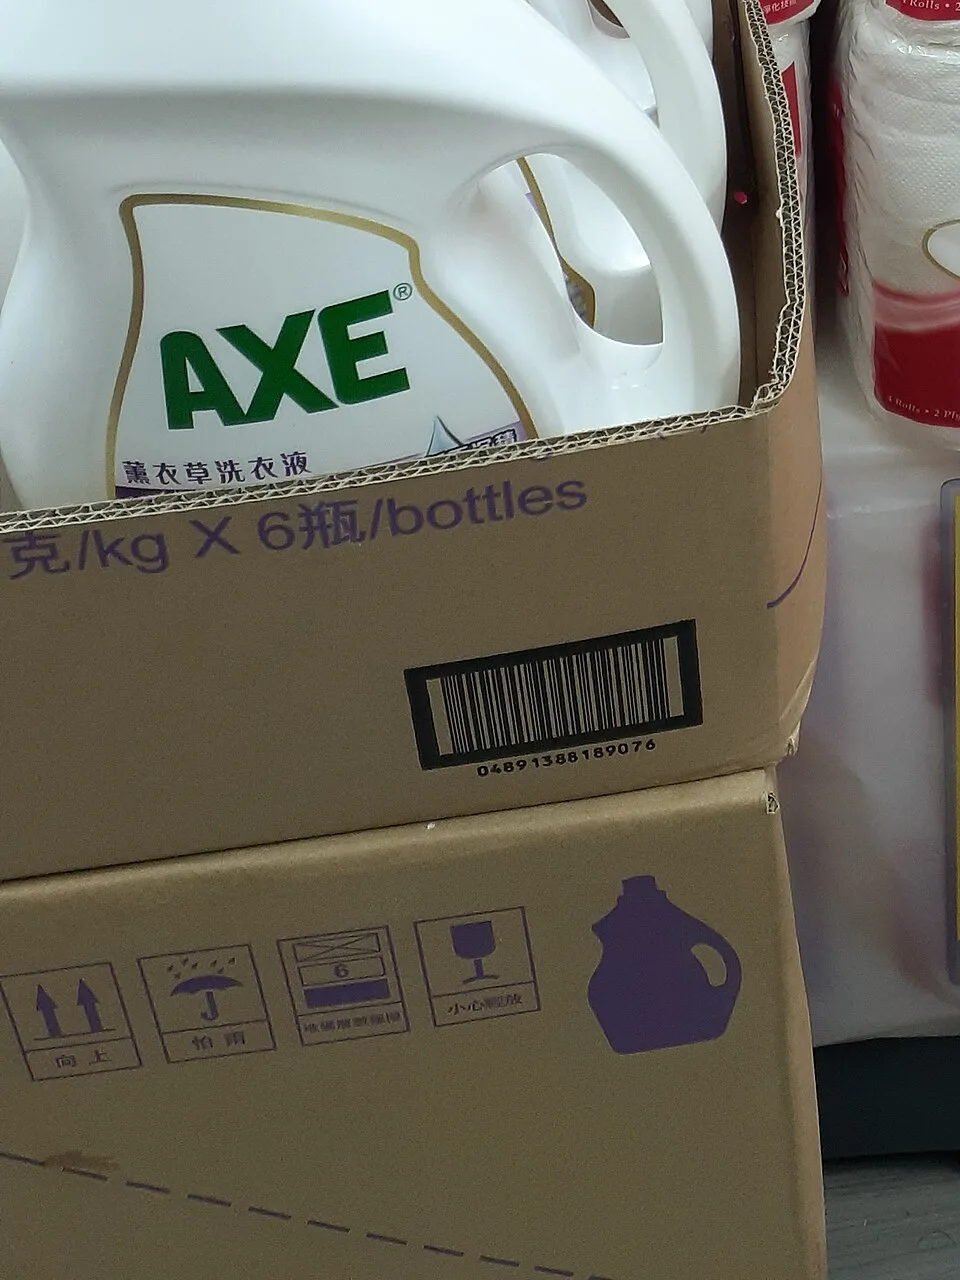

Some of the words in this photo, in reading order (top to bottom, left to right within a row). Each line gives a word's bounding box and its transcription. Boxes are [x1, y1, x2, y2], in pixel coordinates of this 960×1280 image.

[159, 290, 410, 430] AXE
[122, 451, 312, 486] 薰衣草洗衣液
[8, 526, 170, 580] 克/kg
[258, 475, 588, 550] 6瓶/bottles
[56, 1048, 113, 1069] 向上
